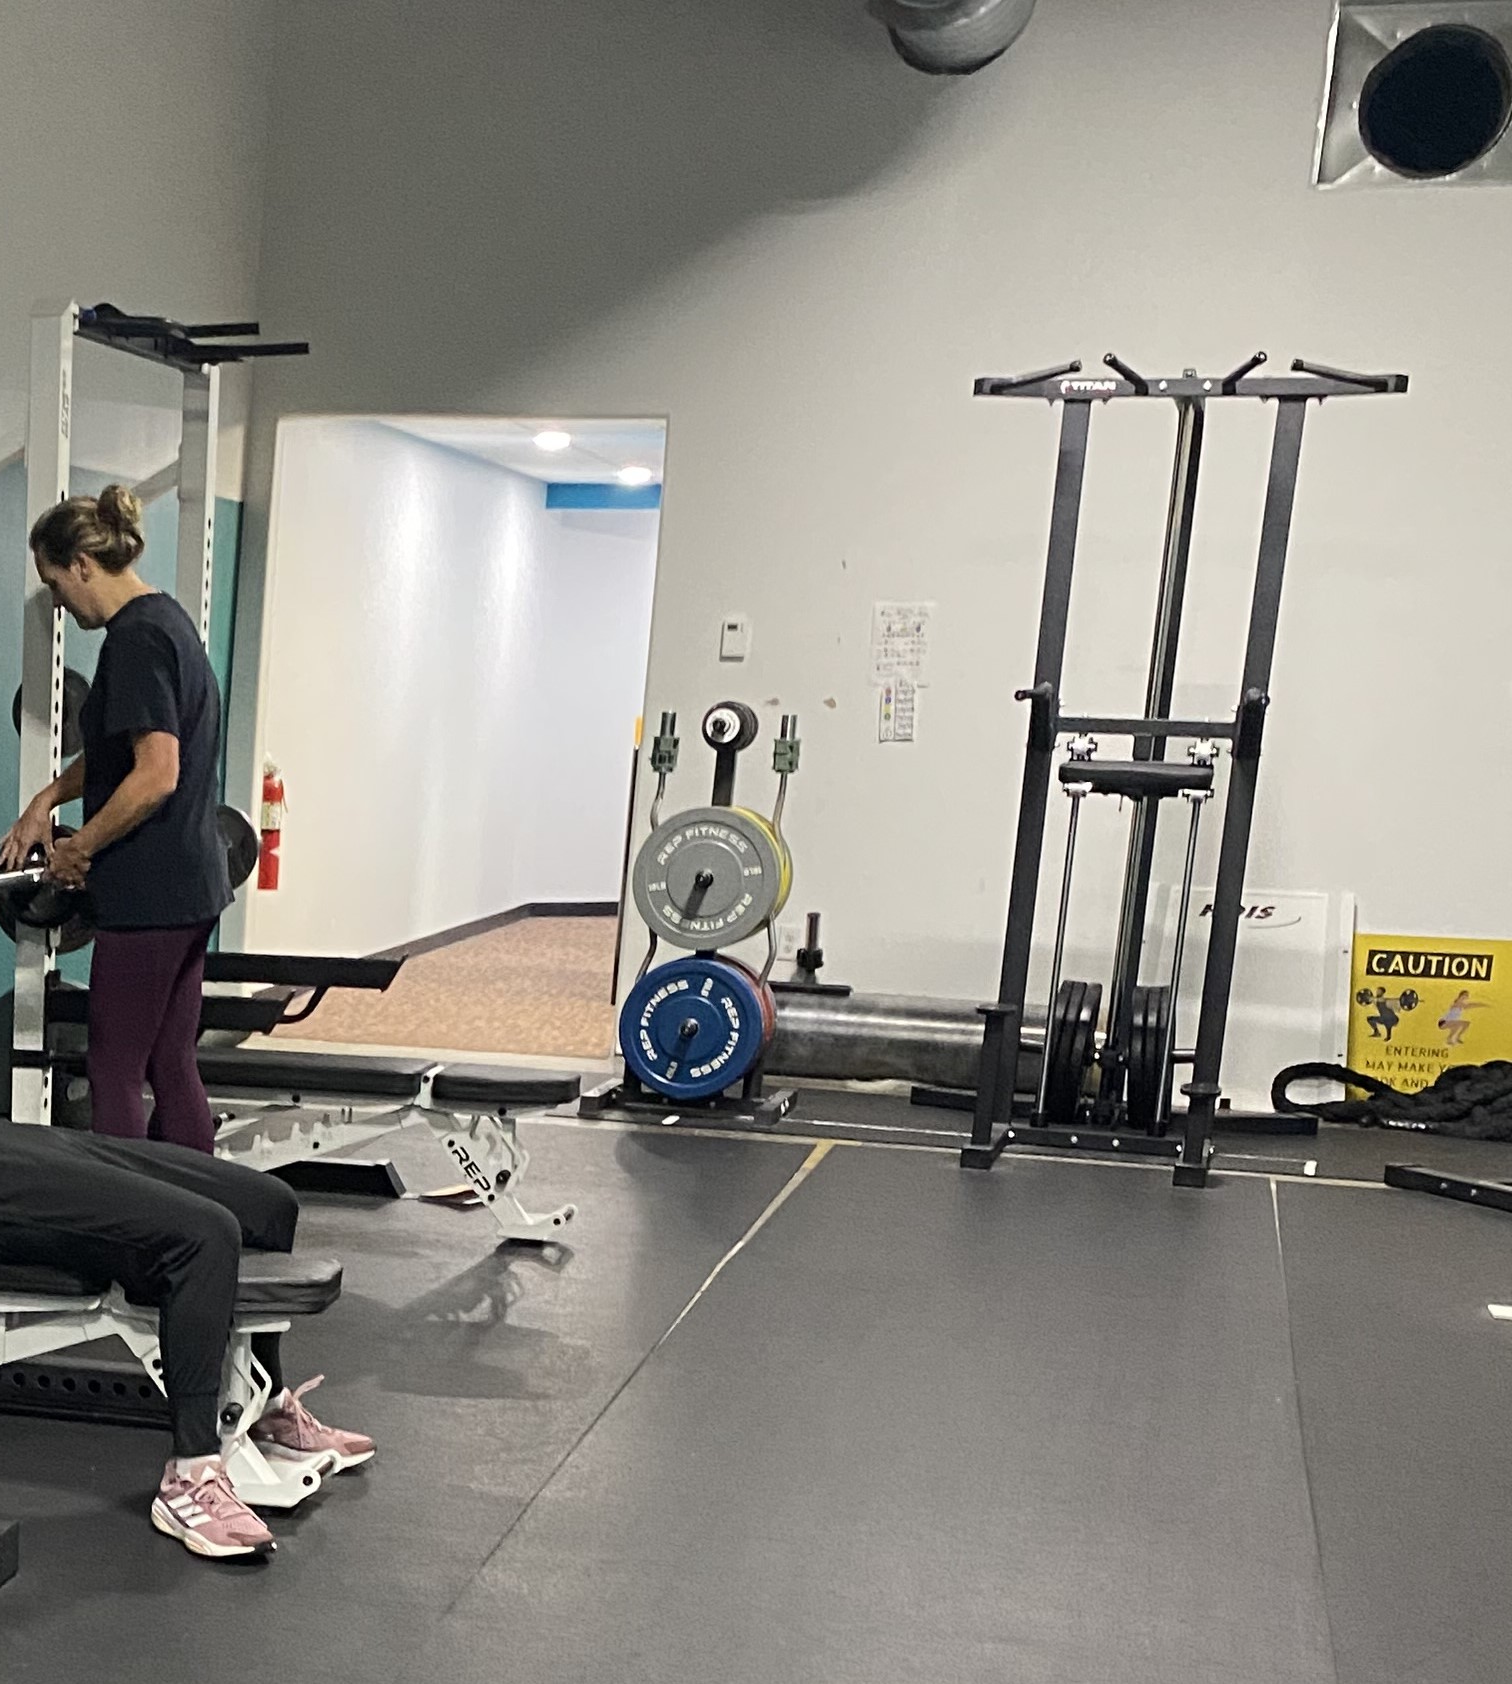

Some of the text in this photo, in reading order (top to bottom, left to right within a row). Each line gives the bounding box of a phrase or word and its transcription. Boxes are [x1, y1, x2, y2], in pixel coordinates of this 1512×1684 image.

[1071, 381, 1117, 391] TITAN
[657, 826, 749, 866] REP FITNESS
[726, 893, 753, 923] REP
[1371, 953, 1489, 979] CAUTION
[640, 979, 689, 1062] REP FITNESS
[690, 997, 740, 1078] REP FITNESS
[1385, 1045, 1449, 1058] ENTERING
[1365, 1060, 1393, 1072] MAY
[1398, 1061, 1435, 1073] MAKE
[1401, 1078, 1429, 1089] AND
[451, 1146, 492, 1192] REP
